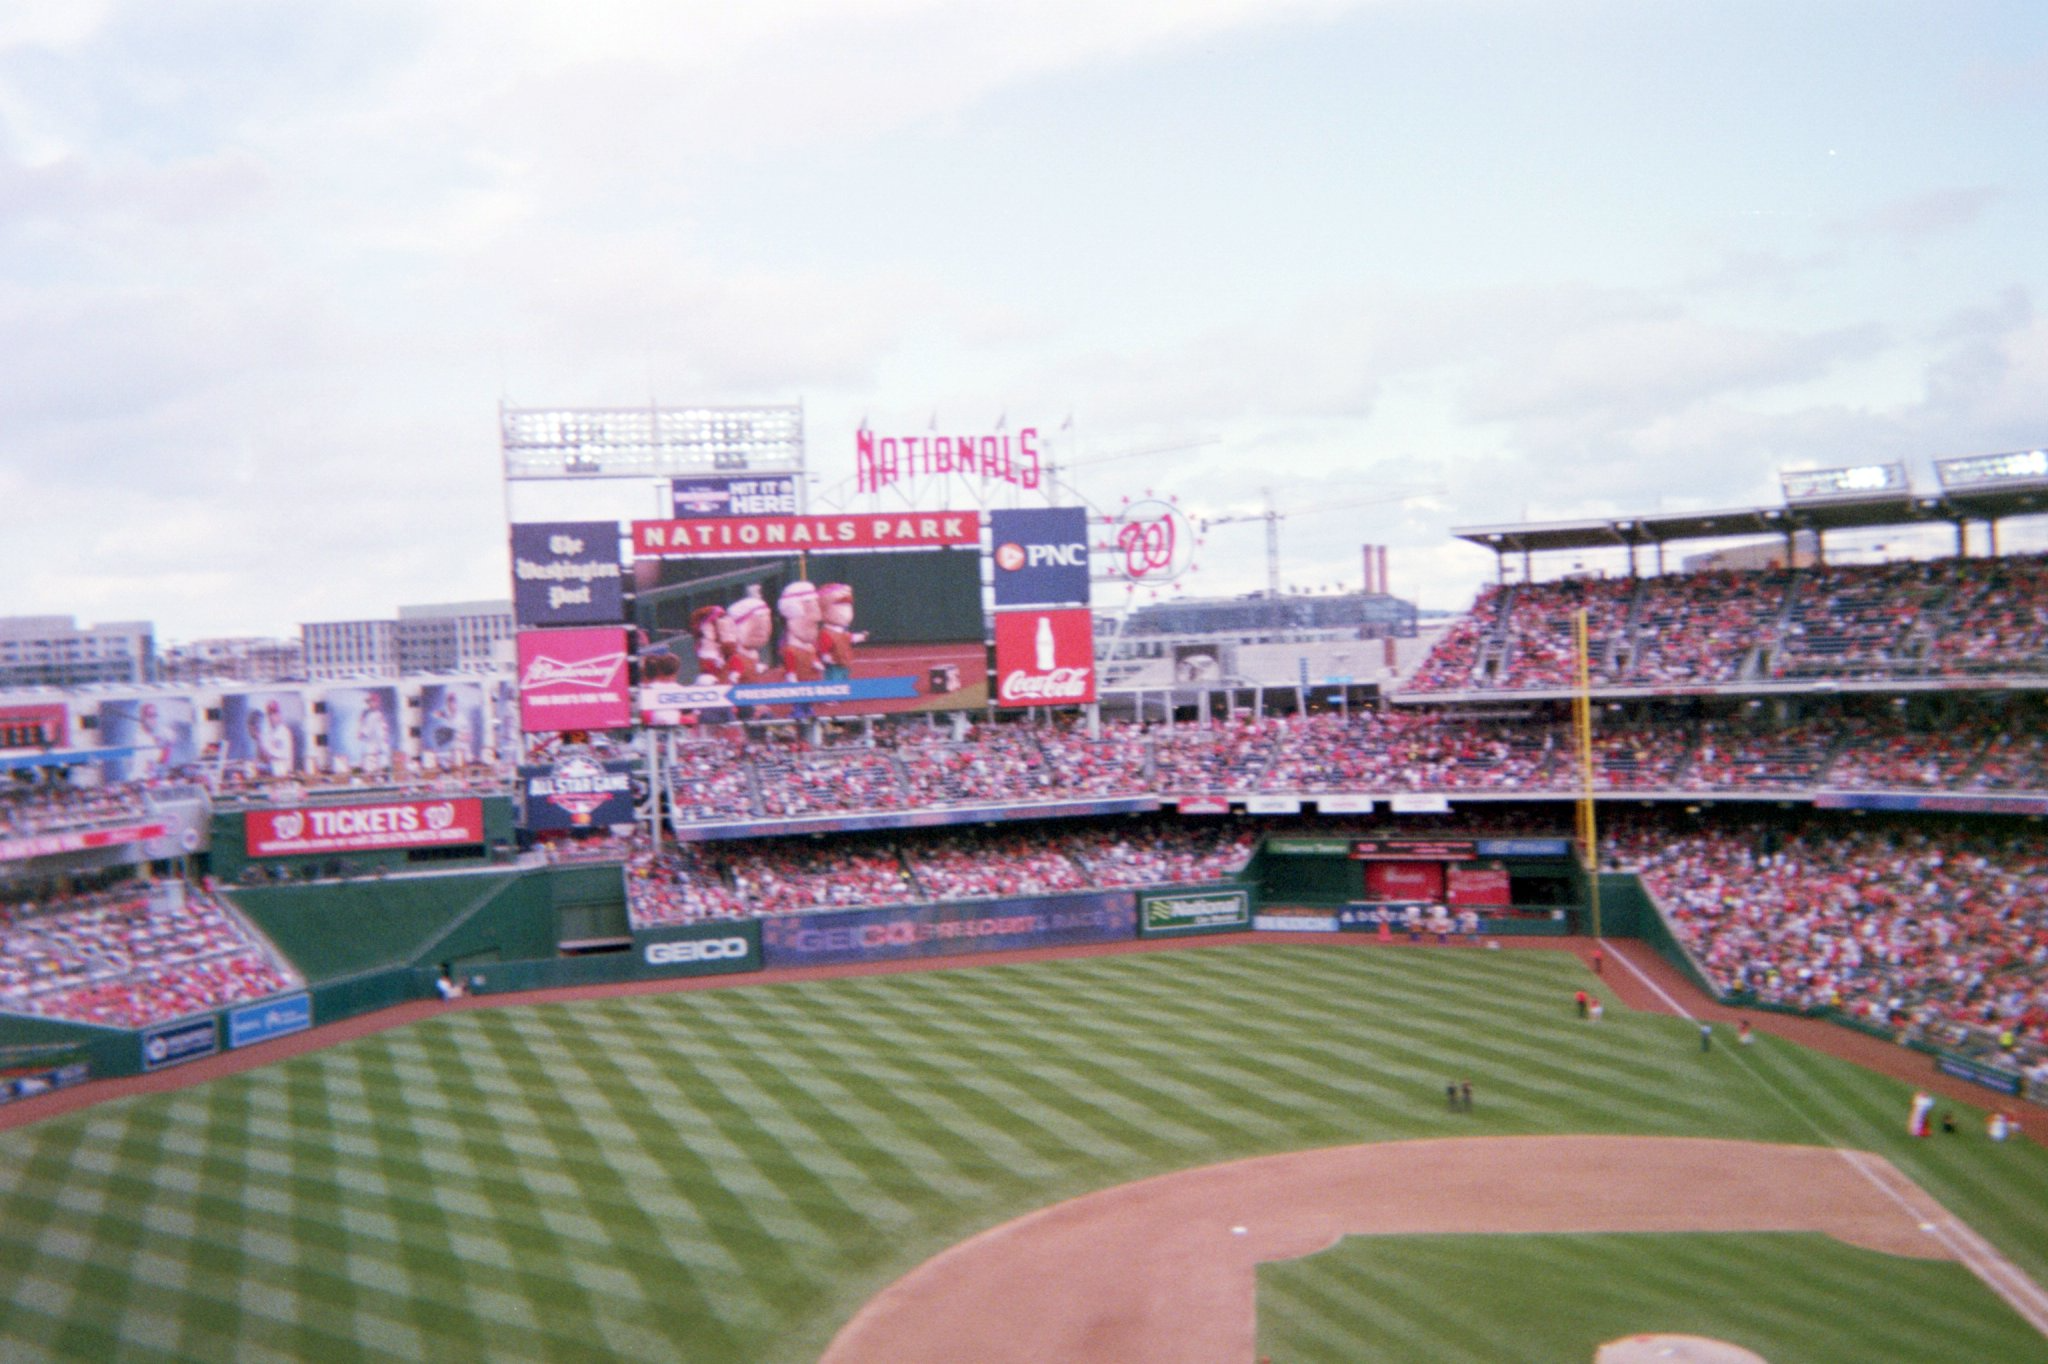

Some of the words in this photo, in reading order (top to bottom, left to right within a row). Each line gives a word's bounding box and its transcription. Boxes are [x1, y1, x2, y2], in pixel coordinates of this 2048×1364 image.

[856, 428, 1040, 493] NATIONALS
[729, 482, 758, 495] HIT
[761, 481, 779, 494] IT
[731, 496, 793, 514] HERE
[644, 521, 856, 547] NATIONALS
[872, 517, 965, 539] PARK
[1026, 543, 1087, 567] PNC
[658, 690, 719, 704] GEICO
[310, 807, 418, 836] TICKETS
[644, 937, 748, 964] GEICO
